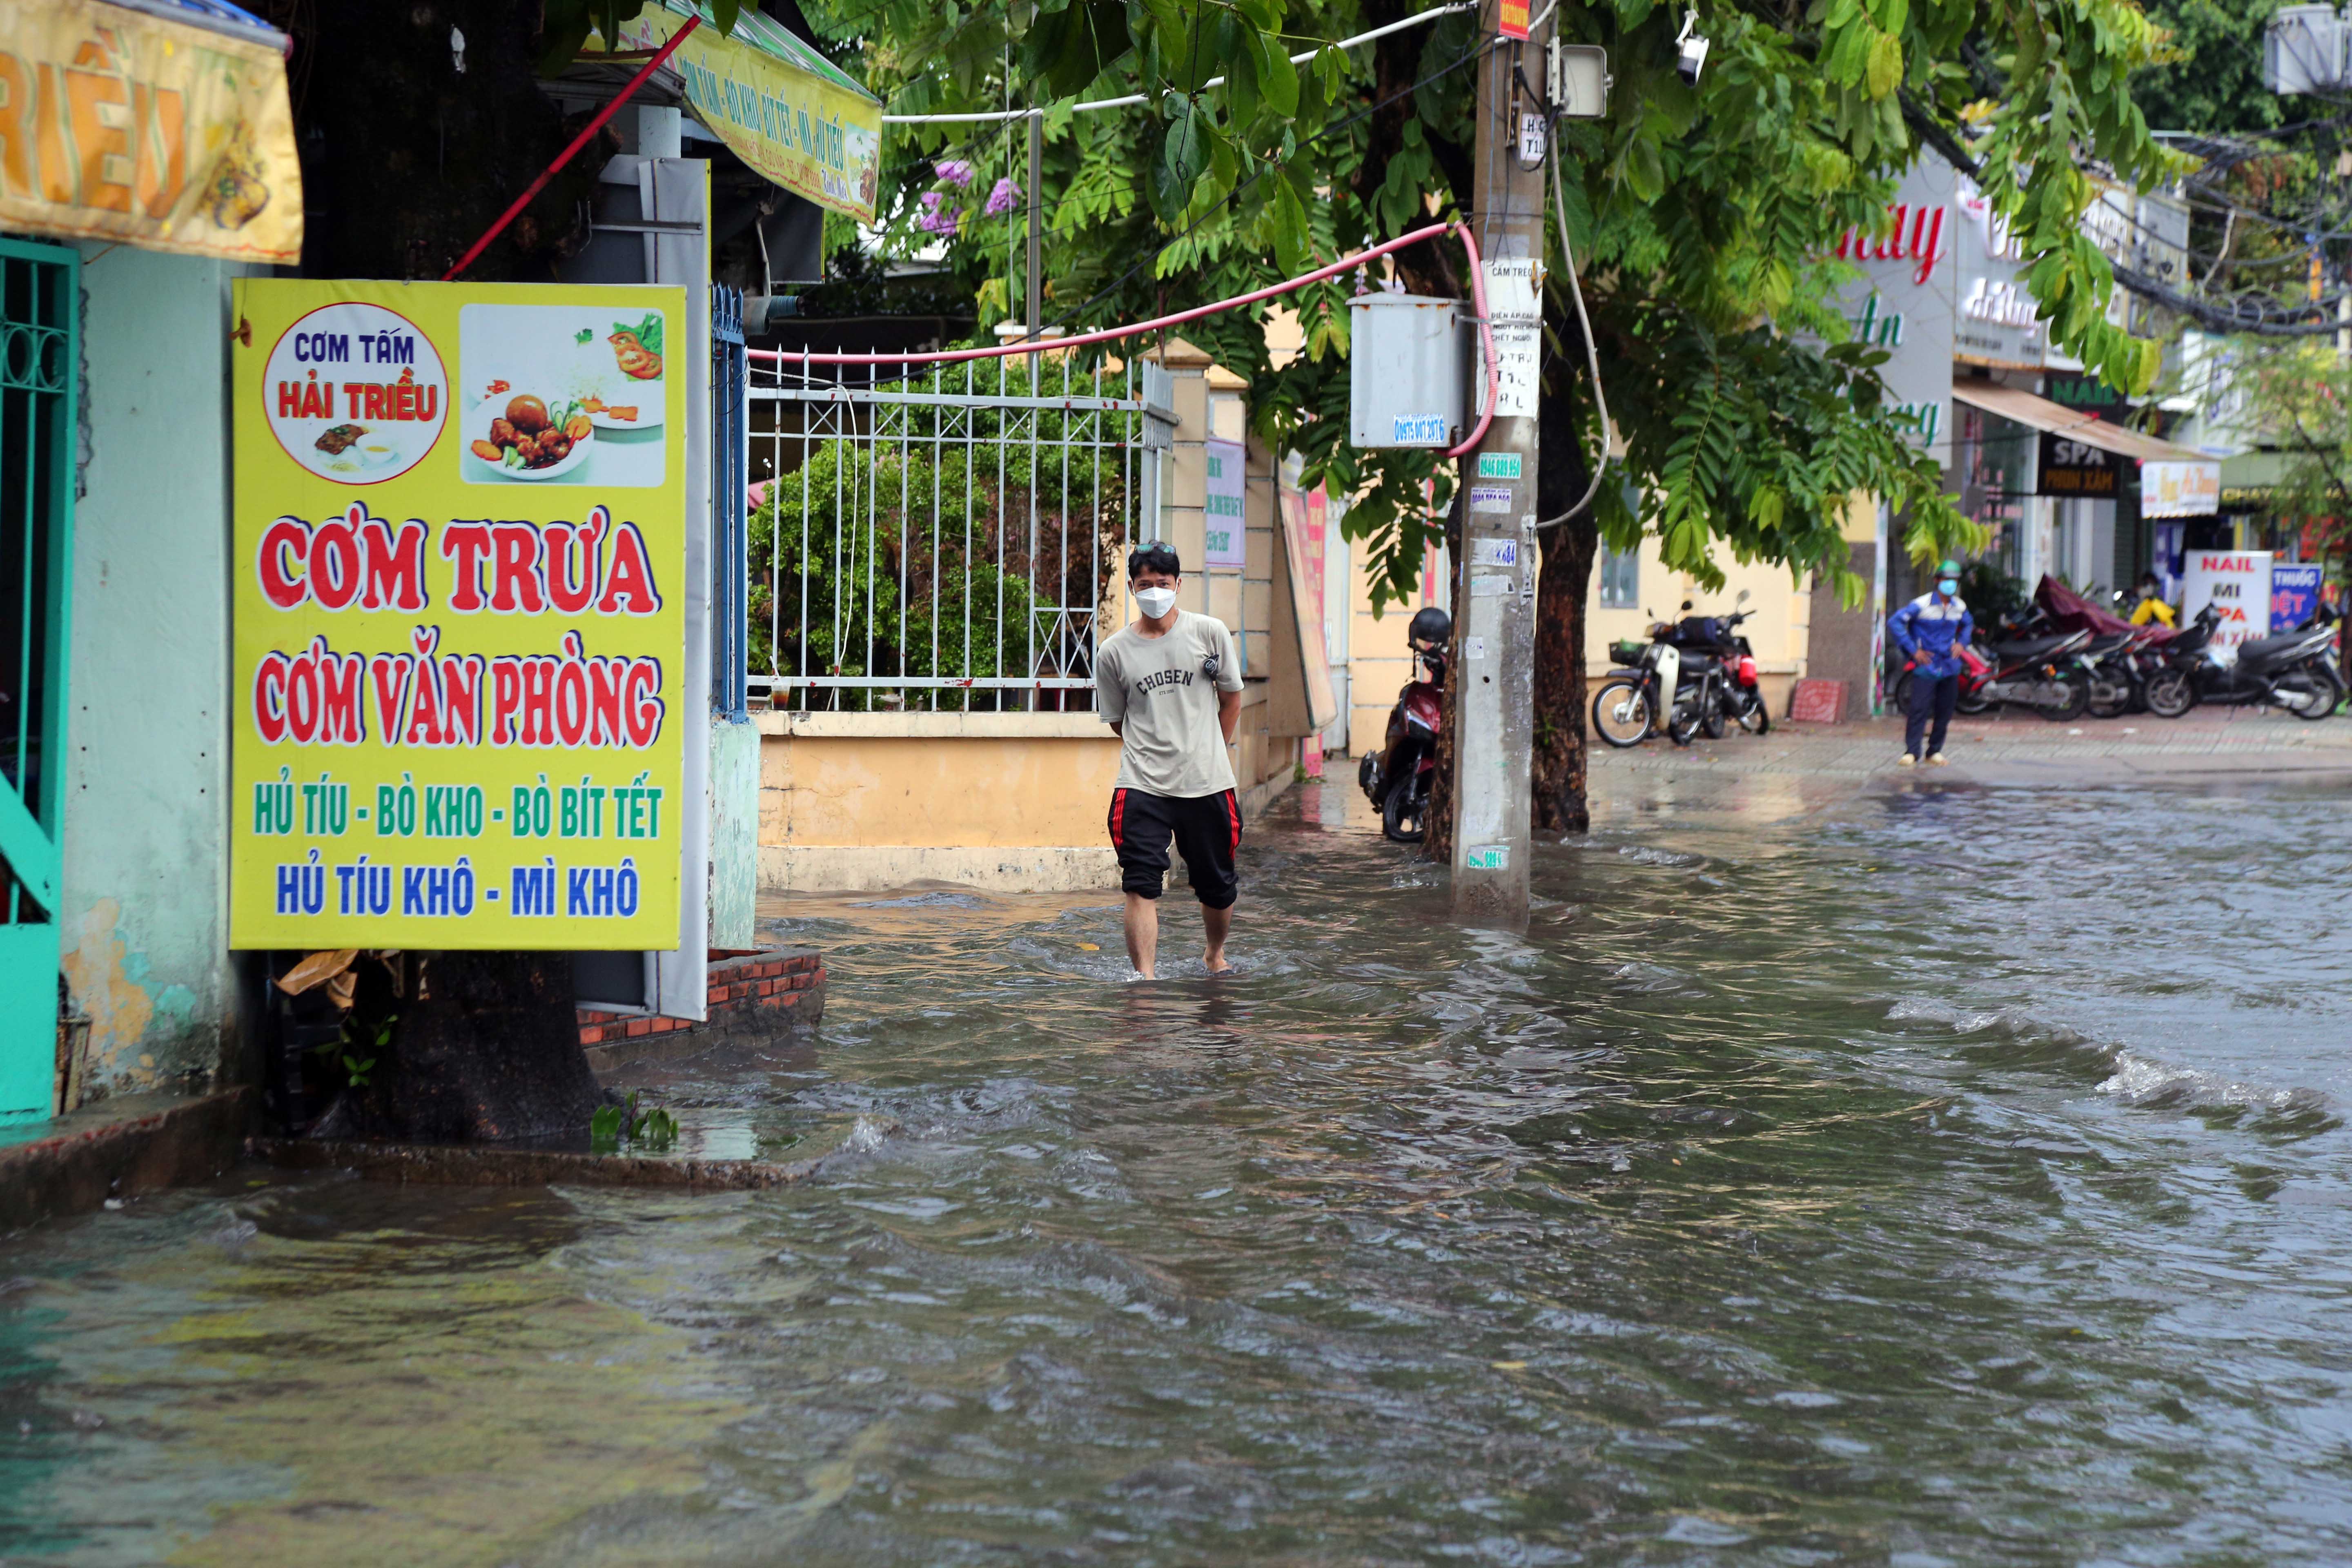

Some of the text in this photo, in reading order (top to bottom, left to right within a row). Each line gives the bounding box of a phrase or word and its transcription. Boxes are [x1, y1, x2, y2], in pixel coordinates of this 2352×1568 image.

[697, 53, 723, 118] TẤM
[724, 69, 742, 126] BÒ
[739, 83, 762, 133] KHO
[762, 86, 778, 142] BÍT
[777, 89, 794, 149] TẾT
[826, 113, 844, 171] TIẾU
[296, 328, 414, 363] CƠM TẤM
[278, 367, 437, 421] HẢI TRIỀU
[2053, 379, 2116, 405] NAIL
[2054, 440, 2105, 466] SPA
[257, 504, 659, 616] CƠM TRƯA
[2202, 556, 2254, 572] NAIL
[2274, 569, 2316, 587] THUỐC
[2218, 608, 2246, 621] PA
[2271, 589, 2306, 617] IỆT
[254, 626, 662, 751] CƠM VĂN PHÒNG
[1136, 670, 1194, 695] CHOSEN
[254, 767, 293, 835] HỦ
[303, 773, 347, 835] TÍU
[377, 773, 416, 837] BÒ
[426, 785, 483, 838] KHO
[513, 773, 551, 837] BÒ
[560, 775, 606, 838] BÍT
[613, 771, 663, 838] TẾT
[277, 849, 323, 915] HỦ
[336, 855, 392, 916] TÍU
[403, 856, 475, 917] KHÔ
[511, 857, 555, 916] MÌ
[568, 858, 639, 918] KHÔ
